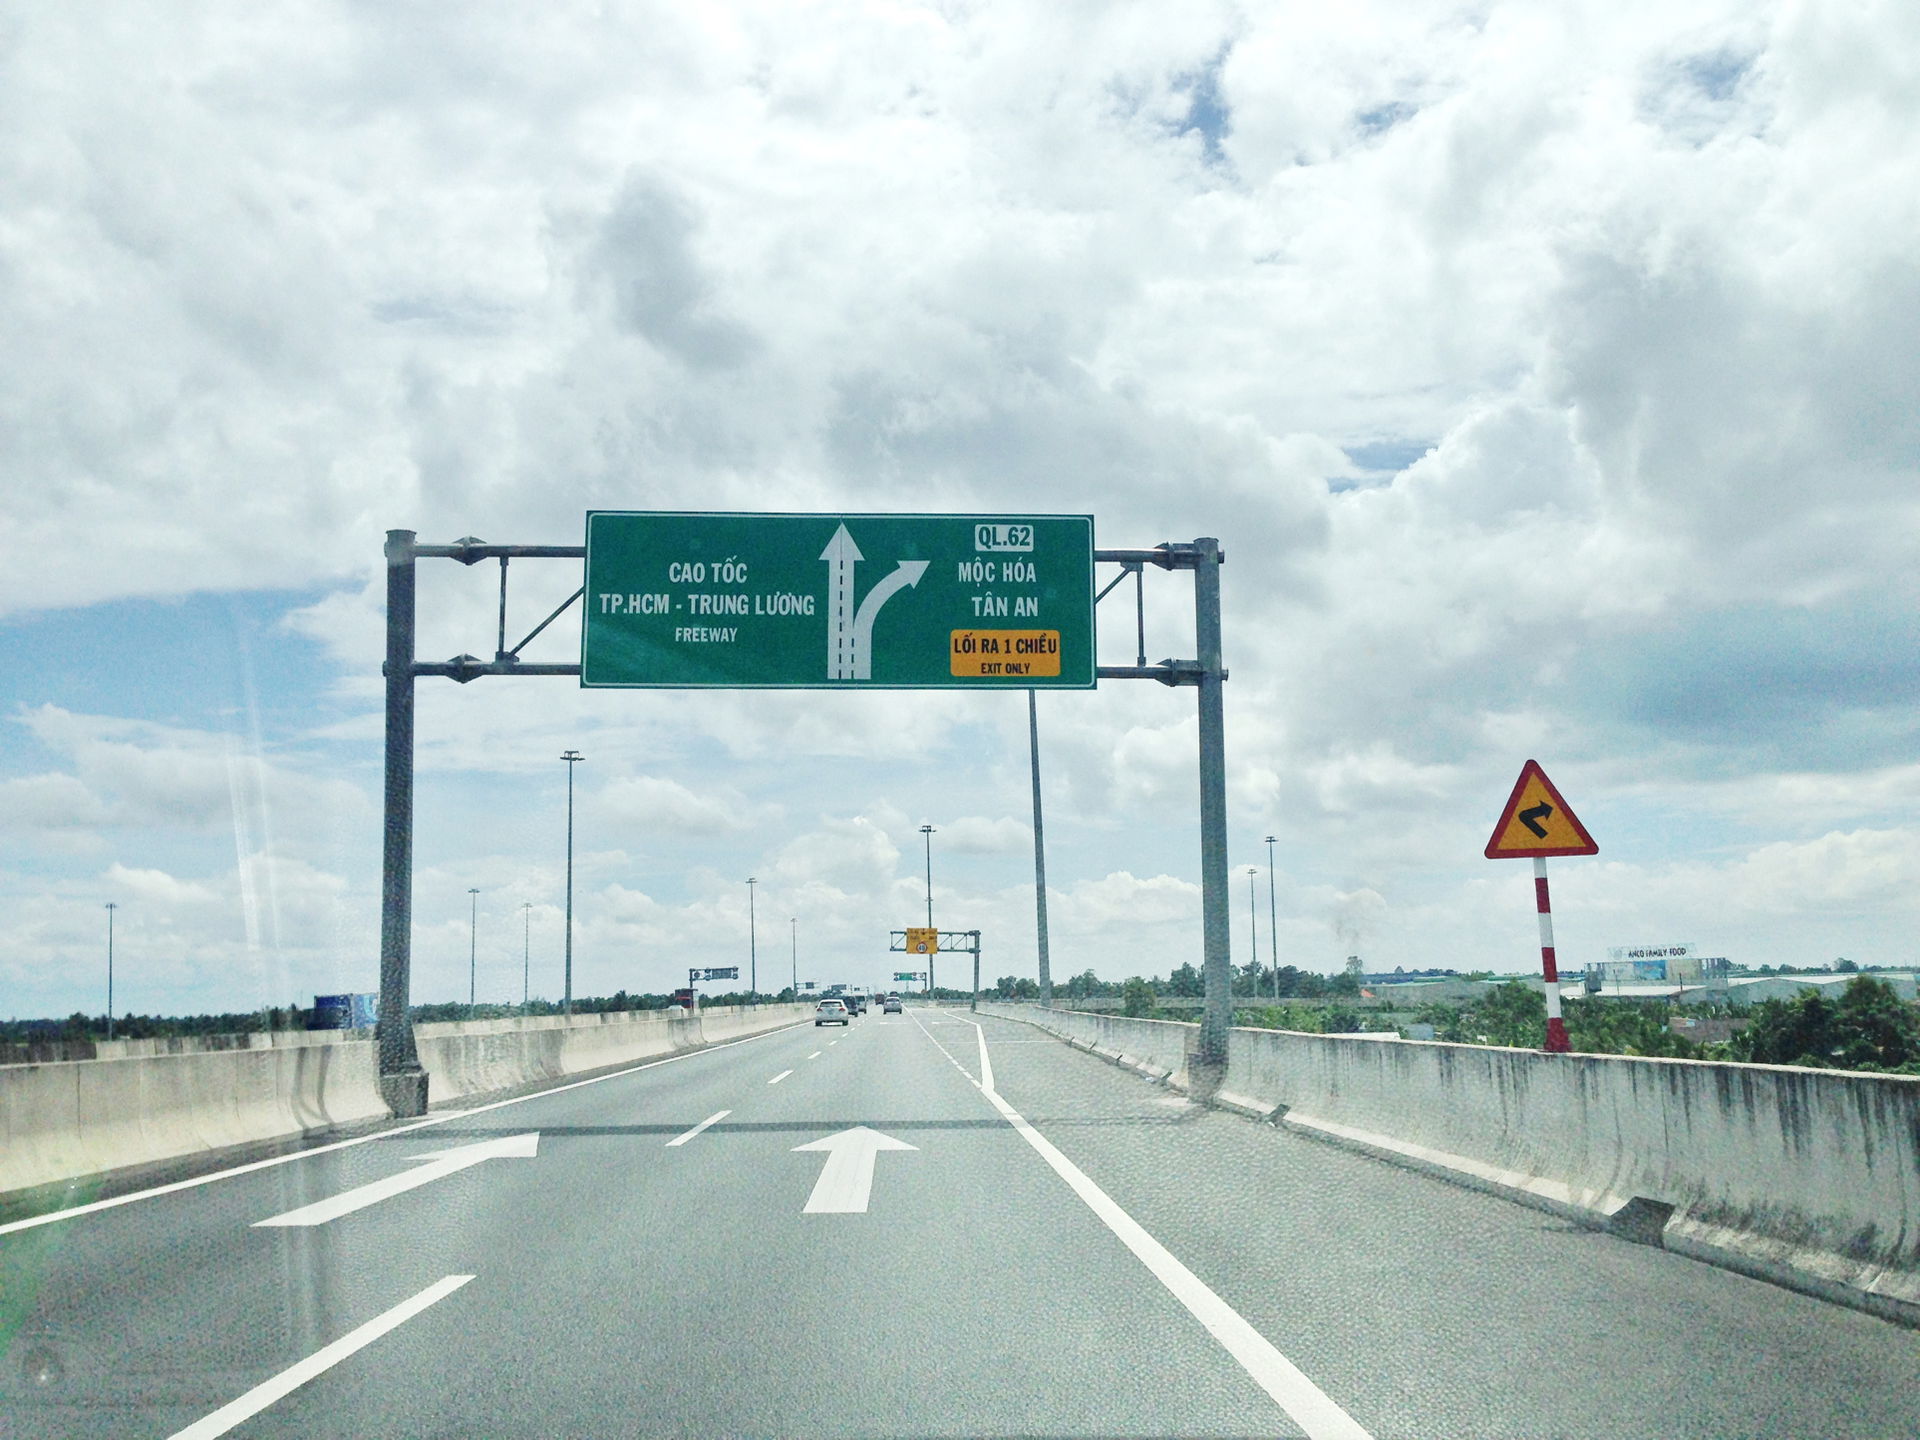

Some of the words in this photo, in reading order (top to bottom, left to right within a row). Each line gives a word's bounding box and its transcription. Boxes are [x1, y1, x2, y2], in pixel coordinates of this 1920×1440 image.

[978, 526, 1030, 549] QL.62
[668, 562, 705, 583] CAO
[711, 555, 748, 583] TỐC
[958, 556, 996, 587] MỘC
[1002, 557, 1037, 582] HÓA
[599, 593, 669, 614] TP.HCM
[688, 595, 749, 615] TRUNG
[755, 591, 815, 616] LƯƠNG
[971, 591, 1008, 616] TÂN
[1013, 597, 1039, 616] AN
[675, 627, 738, 642] FREEWAY
[954, 632, 976, 653] LỐI
[981, 638, 999, 653] RA
[1004, 639, 1012, 653] 1
[1015, 632, 1057, 653] CHIỀU
[981, 663, 1002, 674] EXIT
[1005, 663, 1030, 674] ONLY
[1669, 947, 1687, 956] FOOD
